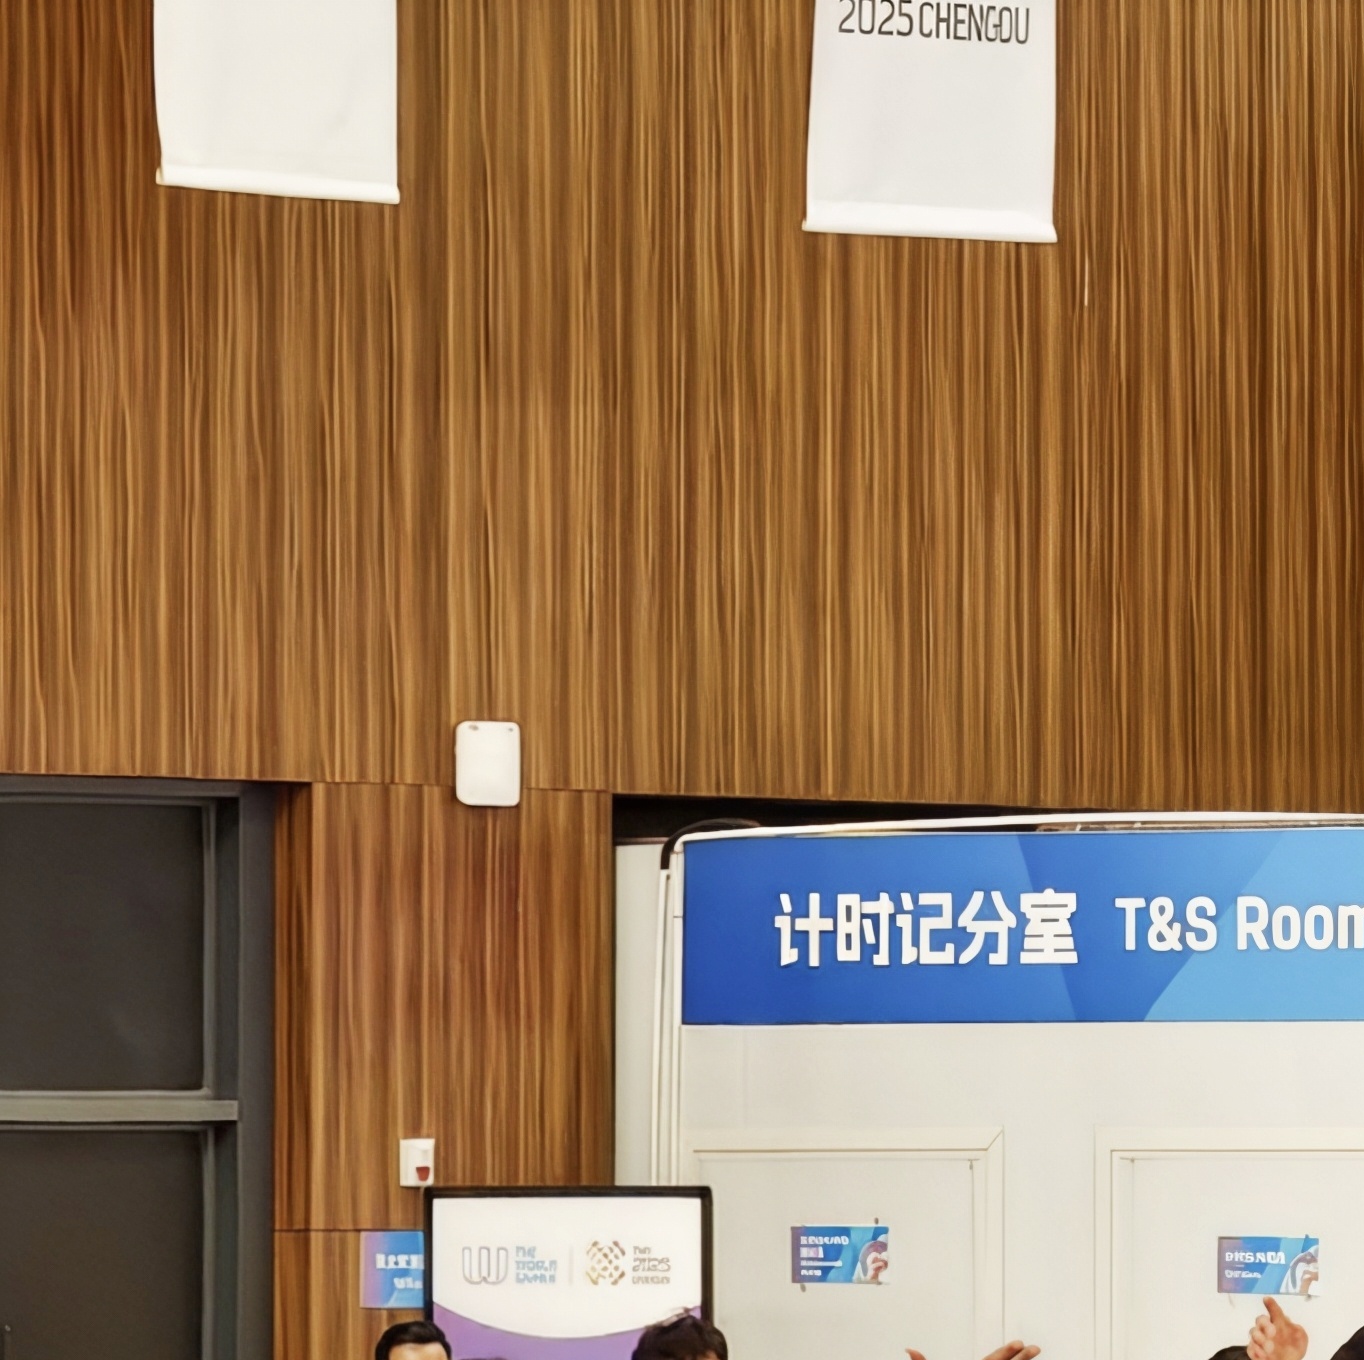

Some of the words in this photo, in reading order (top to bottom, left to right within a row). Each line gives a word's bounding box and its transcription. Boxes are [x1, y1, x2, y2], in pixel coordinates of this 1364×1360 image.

[838, 0, 915, 37] 2025
[774, 888, 1078, 967] 计时记分室
[1114, 896, 1218, 952] T&S
